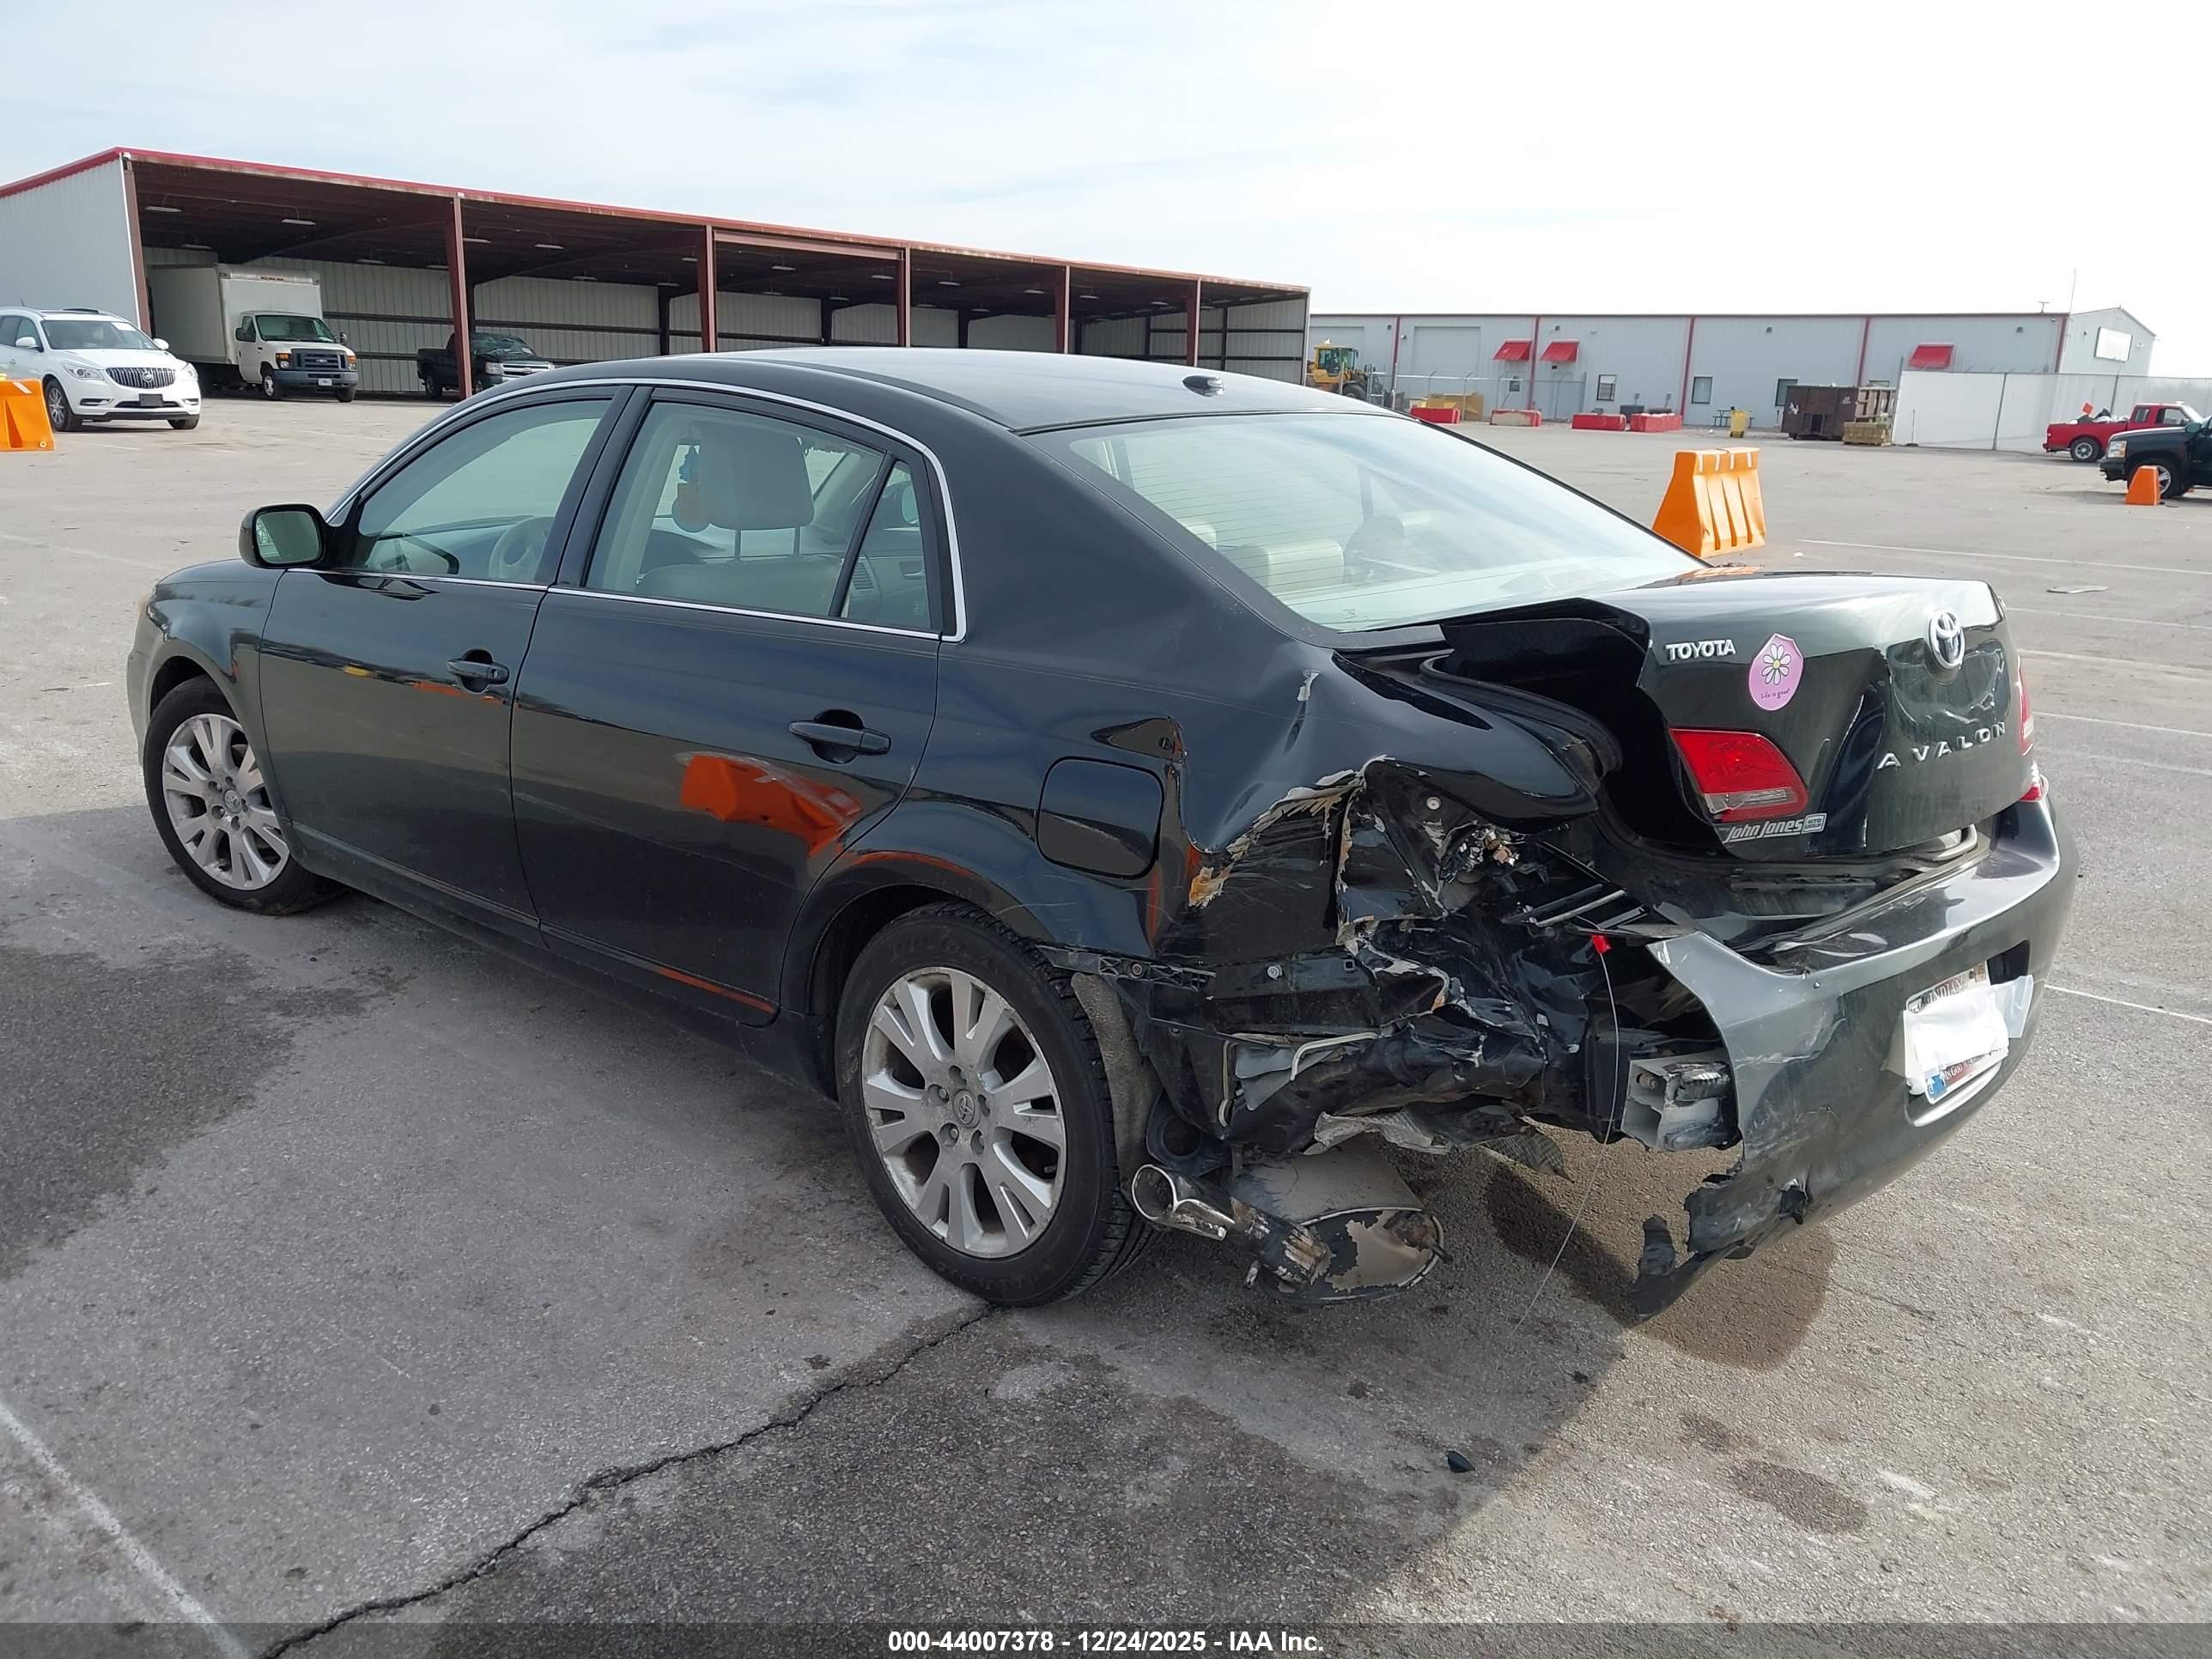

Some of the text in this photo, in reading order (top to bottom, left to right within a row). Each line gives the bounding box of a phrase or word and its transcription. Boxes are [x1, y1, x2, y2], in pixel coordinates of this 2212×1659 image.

[1665, 639, 1736, 661] TOYOTA
[1876, 721, 2006, 770] AVALON
[1723, 818, 1804, 844] John Jones
